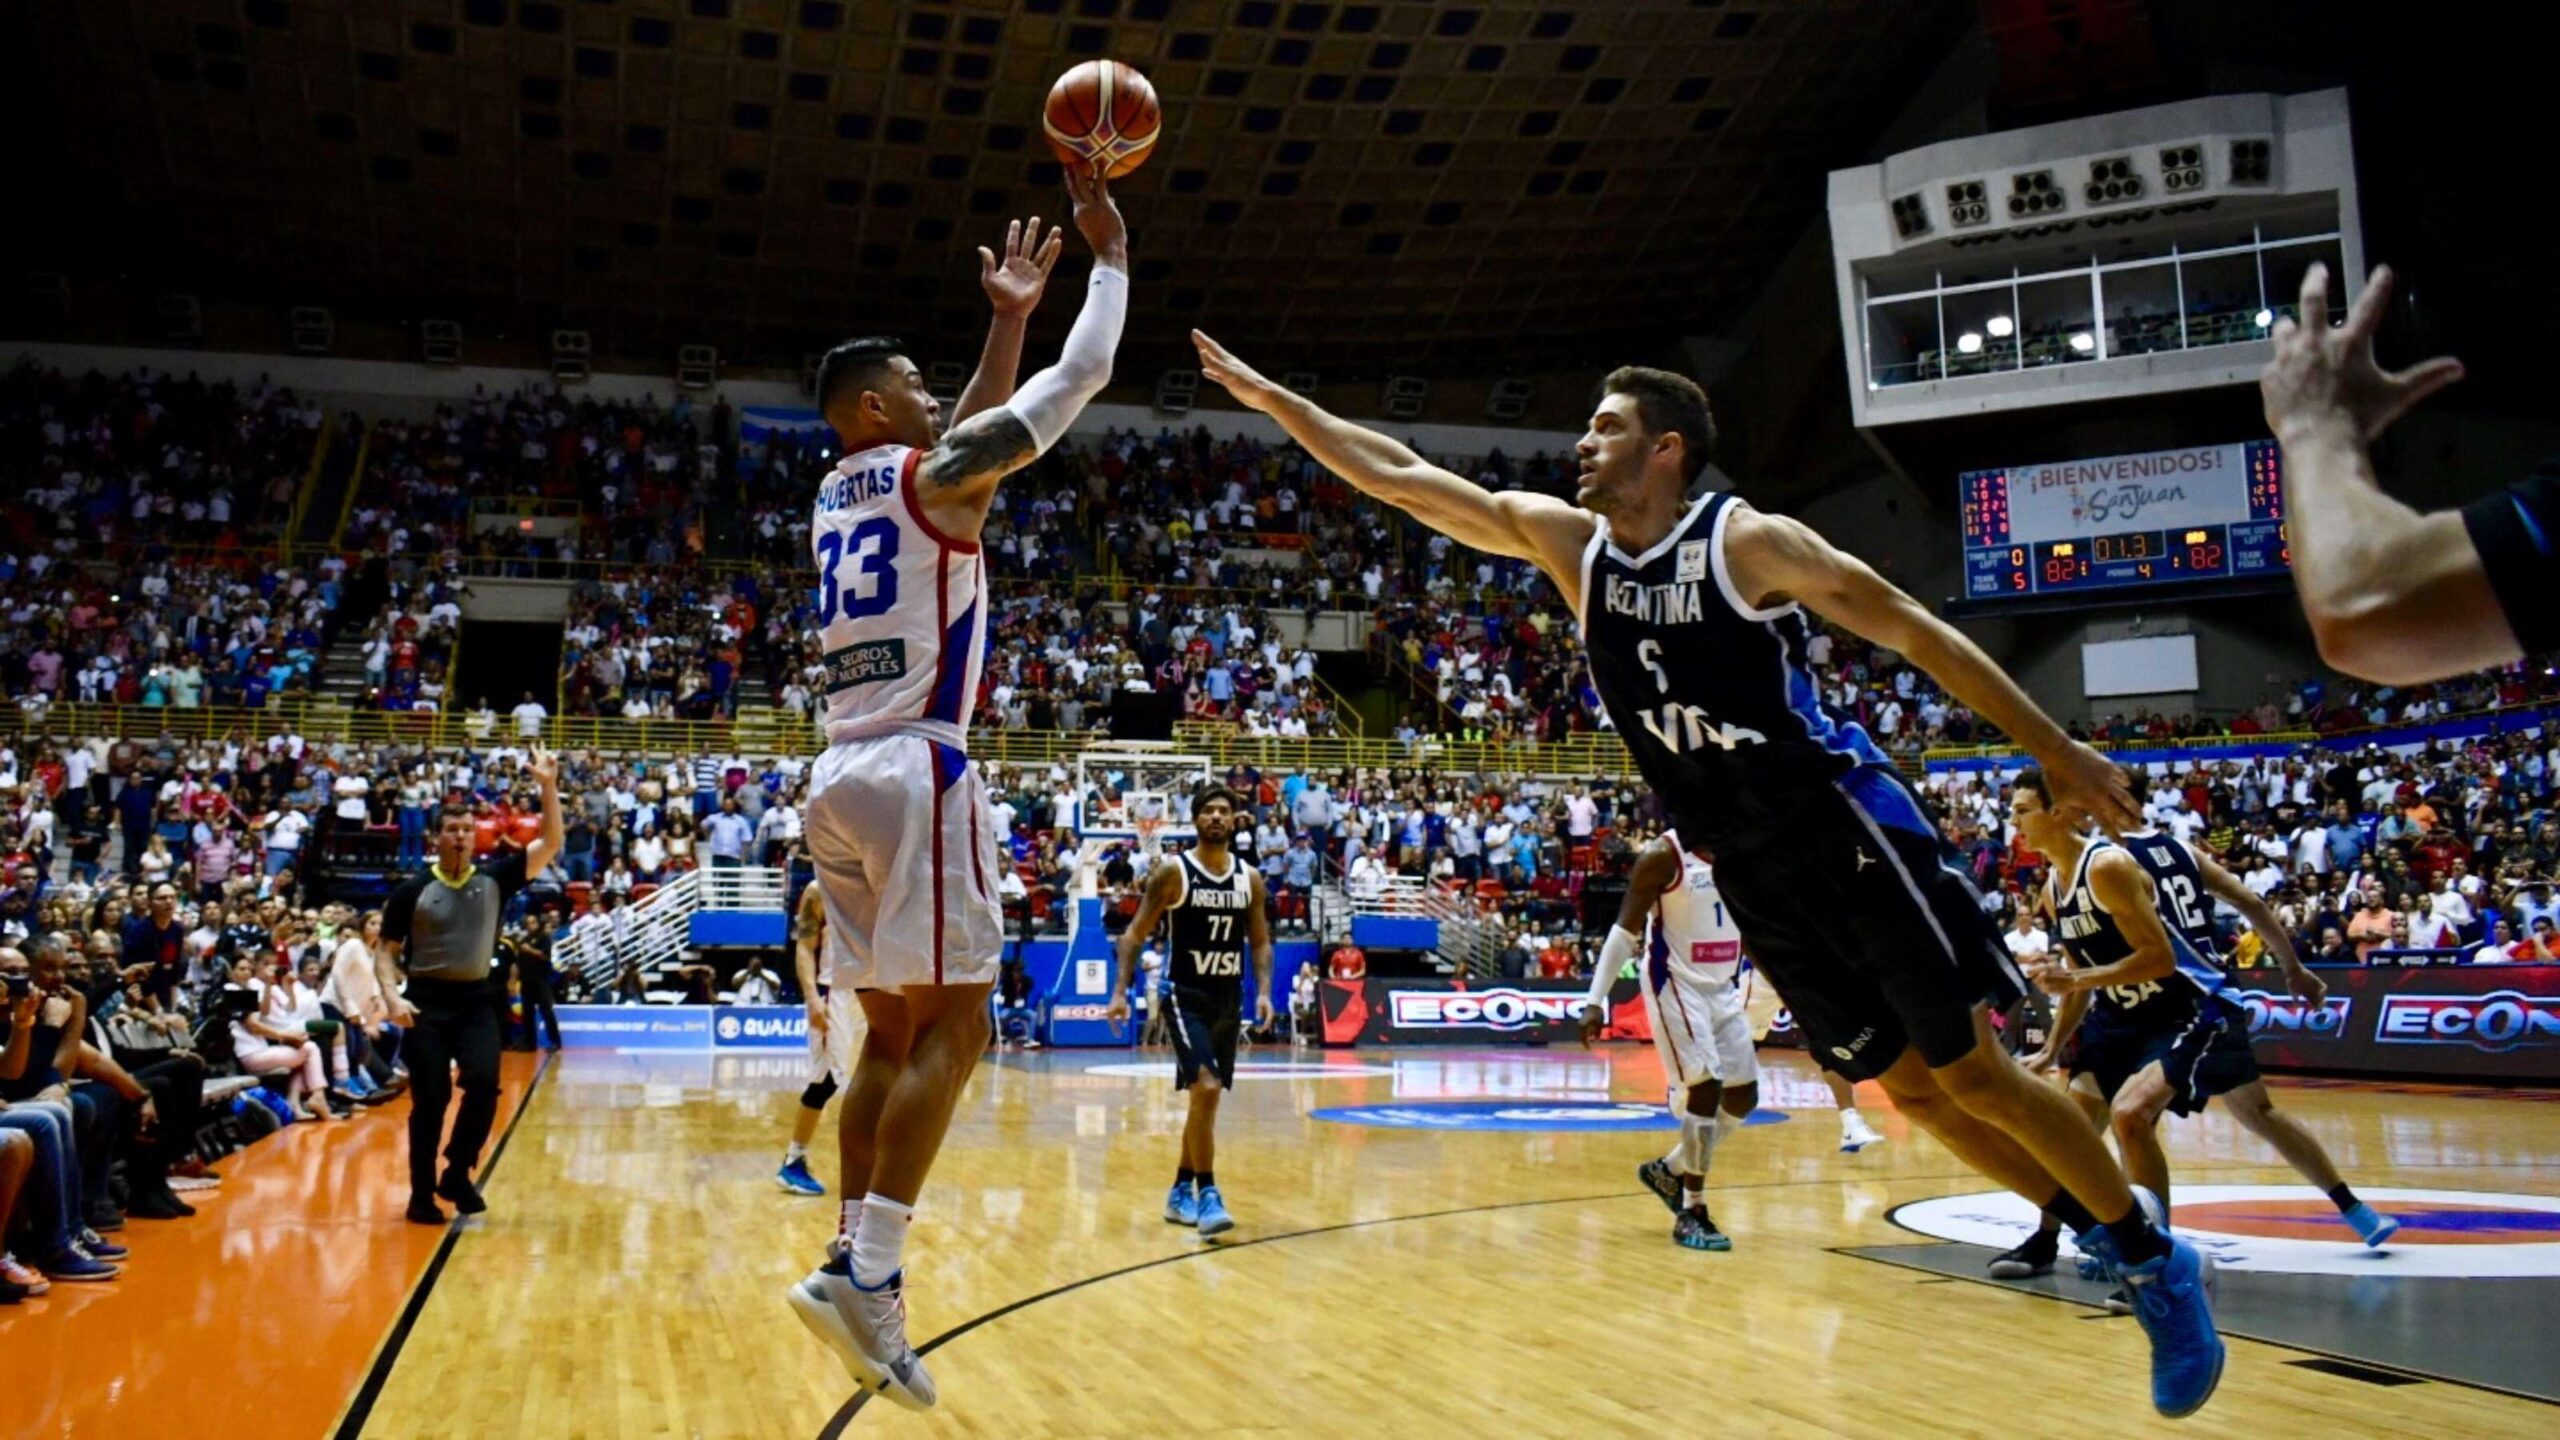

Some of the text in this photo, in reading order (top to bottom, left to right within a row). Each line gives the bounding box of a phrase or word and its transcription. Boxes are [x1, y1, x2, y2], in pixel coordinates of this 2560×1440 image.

[2031, 450, 2222, 495] ¡BIENVENIDOS!
[818, 466, 895, 514] HUERTAS
[2011, 549, 2024, 566] 0
[2191, 545, 2221, 569] 82
[818, 516, 899, 630] 33
[2013, 571, 2026, 590] 5
[2046, 559, 2075, 582] 82
[2139, 564, 2151, 578] 4
[1605, 573, 1703, 625] ANTINA
[2160, 874, 2206, 929] 12
[1208, 915, 1233, 941] 77
